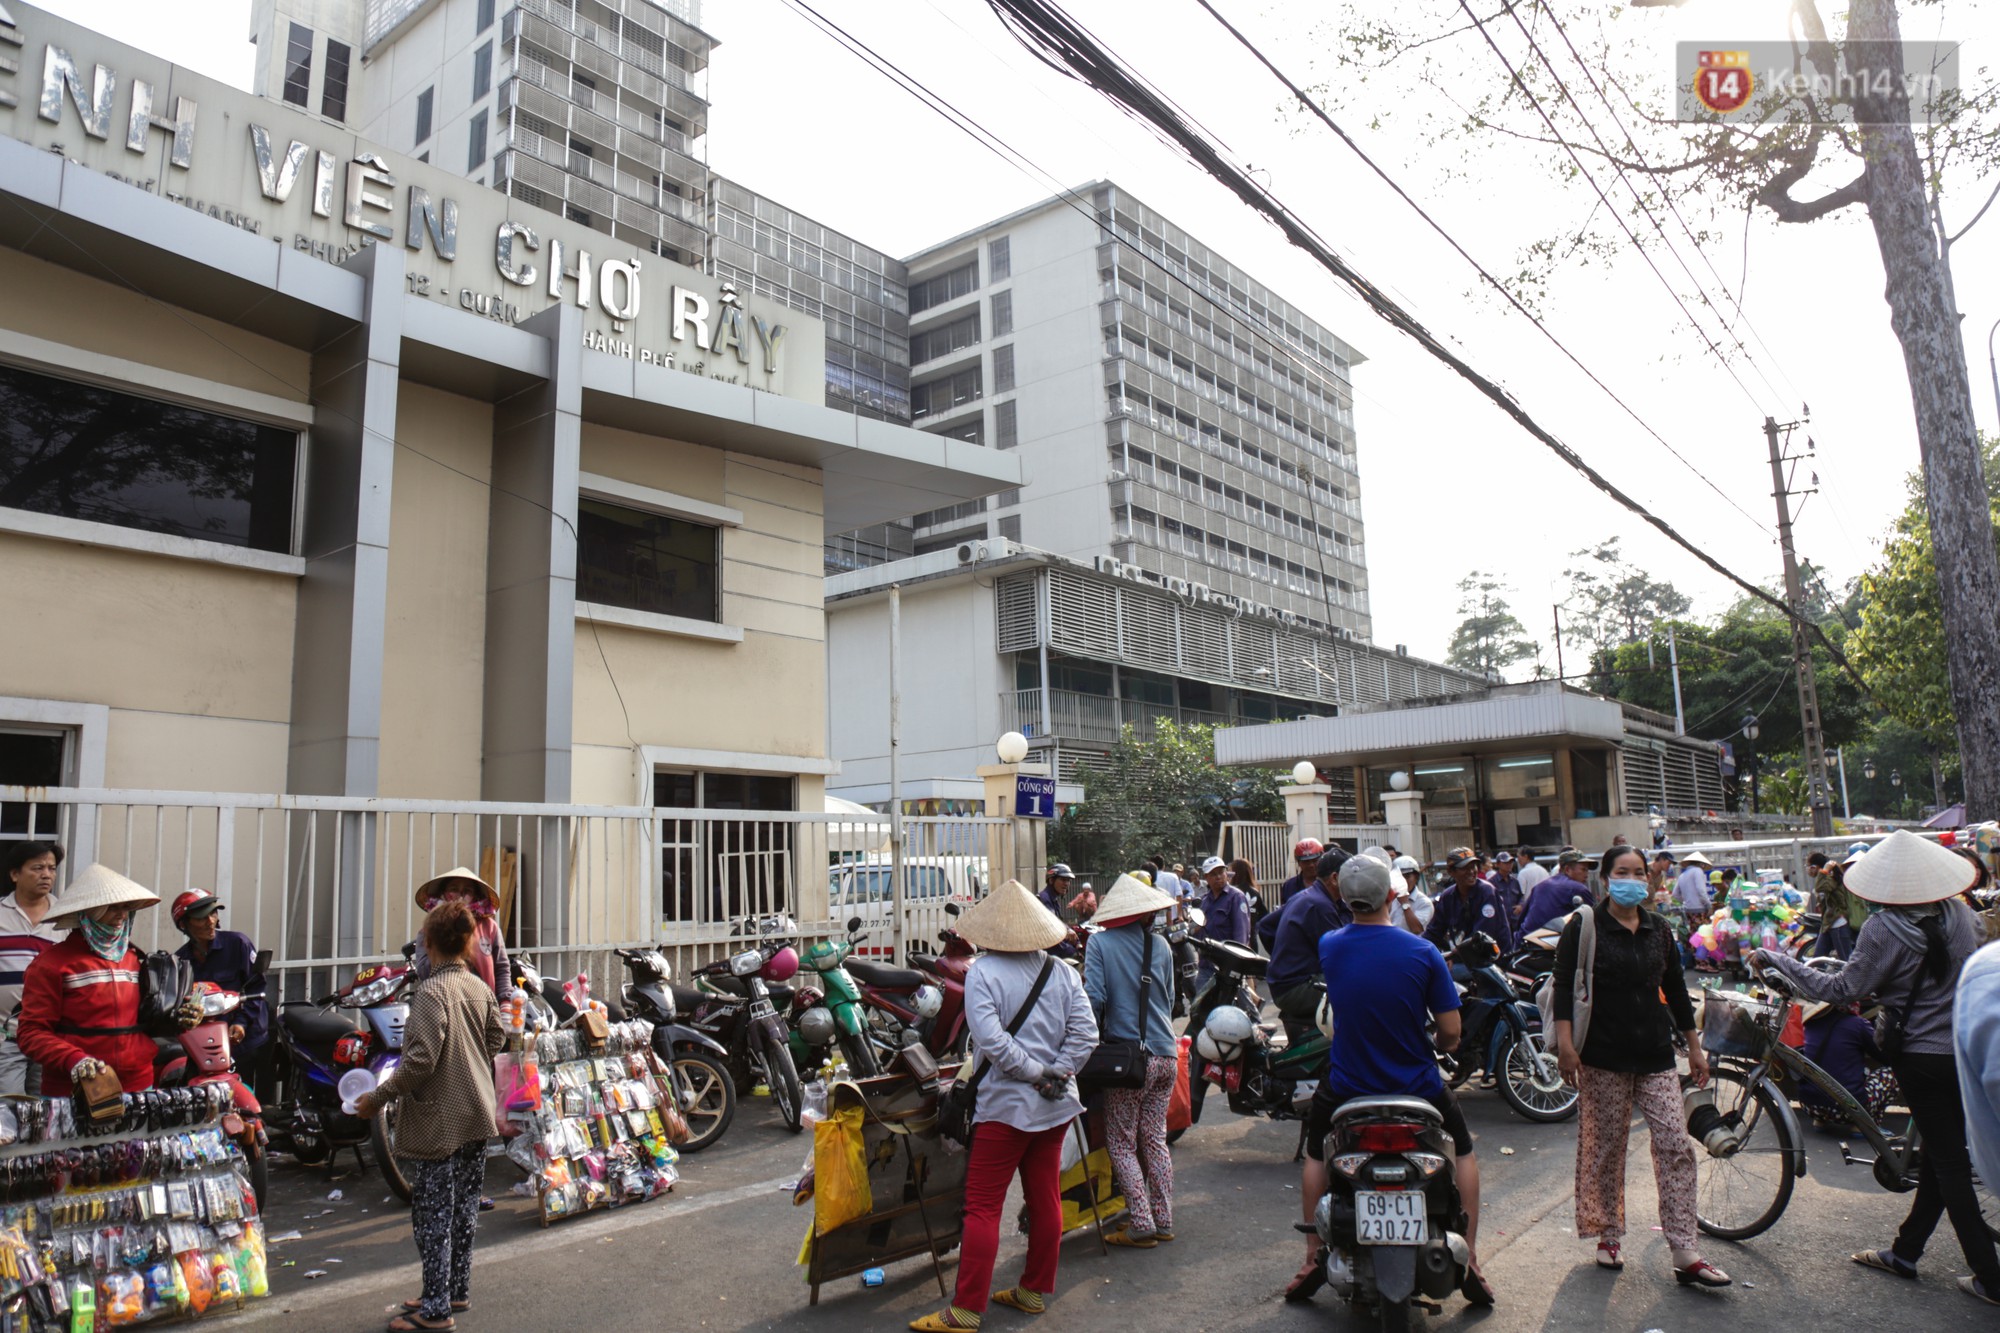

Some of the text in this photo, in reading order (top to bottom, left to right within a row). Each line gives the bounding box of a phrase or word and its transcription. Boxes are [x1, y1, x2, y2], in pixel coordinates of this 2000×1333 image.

[406, 272, 431, 297] 12
[496, 220, 642, 333] CHỢ
[670, 282, 788, 374] RẪY
[1029, 795, 1043, 815] 1
[357, 968, 375, 981] 03
[1362, 1220, 1422, 1241] 230.27
